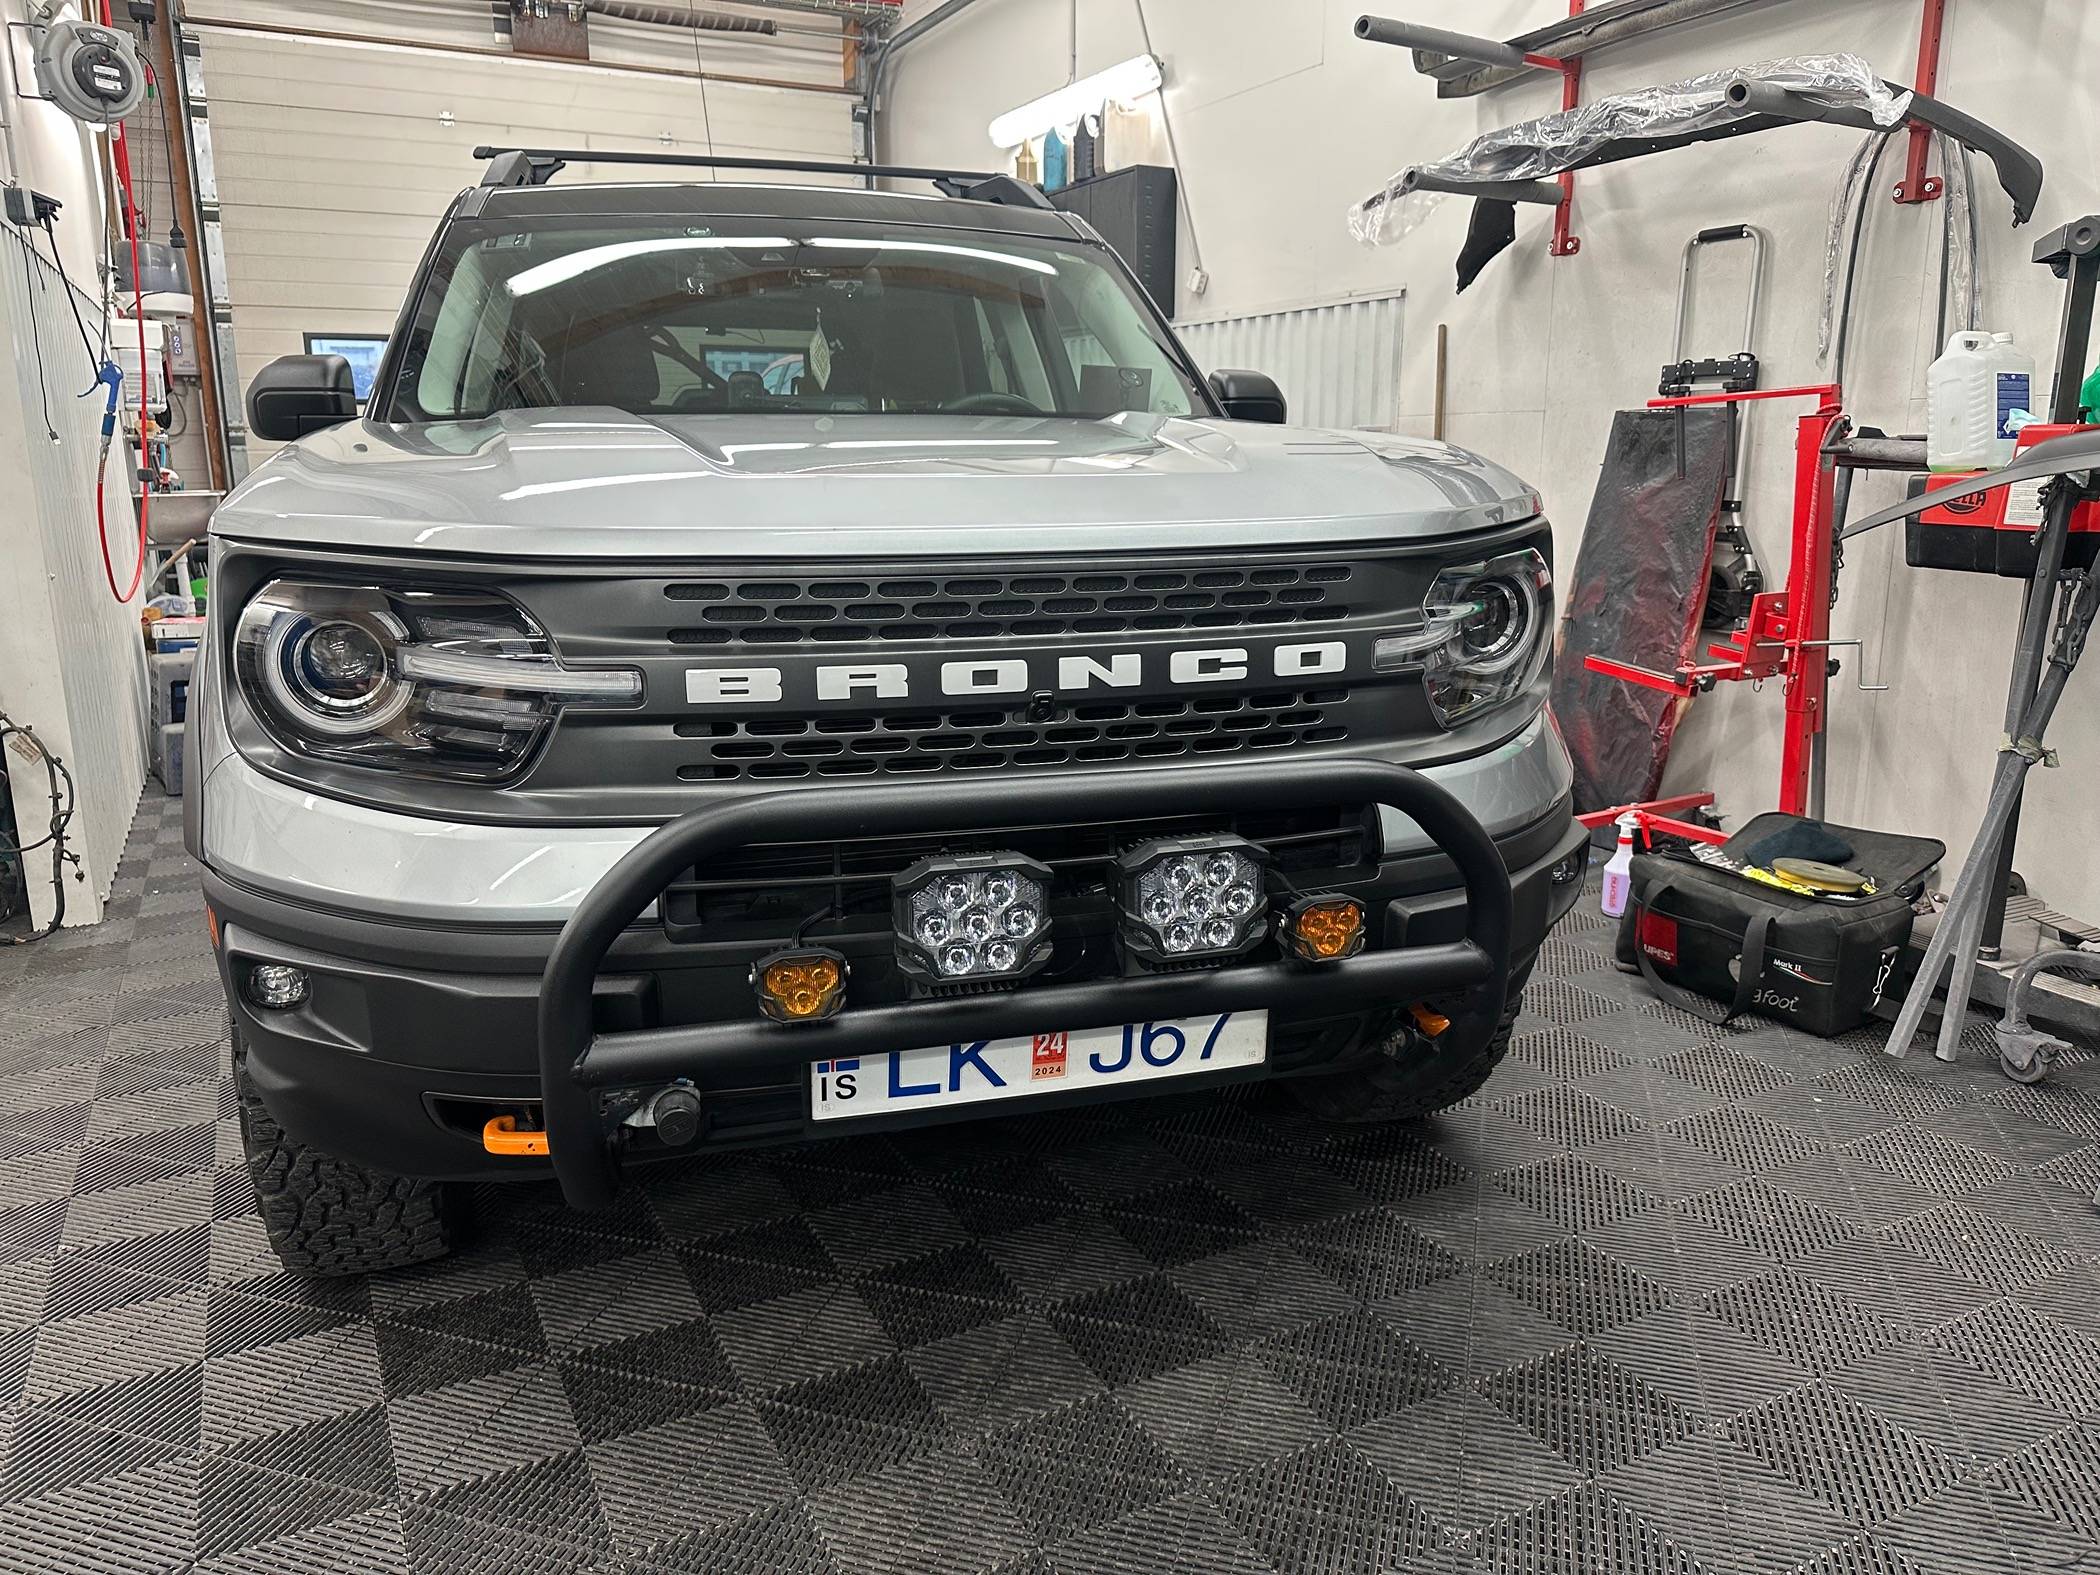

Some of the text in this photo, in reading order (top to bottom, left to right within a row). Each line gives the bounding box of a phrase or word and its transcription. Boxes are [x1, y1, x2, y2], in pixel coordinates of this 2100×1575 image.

[685, 641, 1347, 705] BRONCO
[1643, 943, 1671, 961] UPES
[1773, 958, 1794, 970] Mark
[887, 1013, 1233, 1099] LK J67
[1036, 1032, 1064, 1057] 24
[1035, 1065, 1062, 1076] 2024
[821, 1074, 858, 1102] IS
